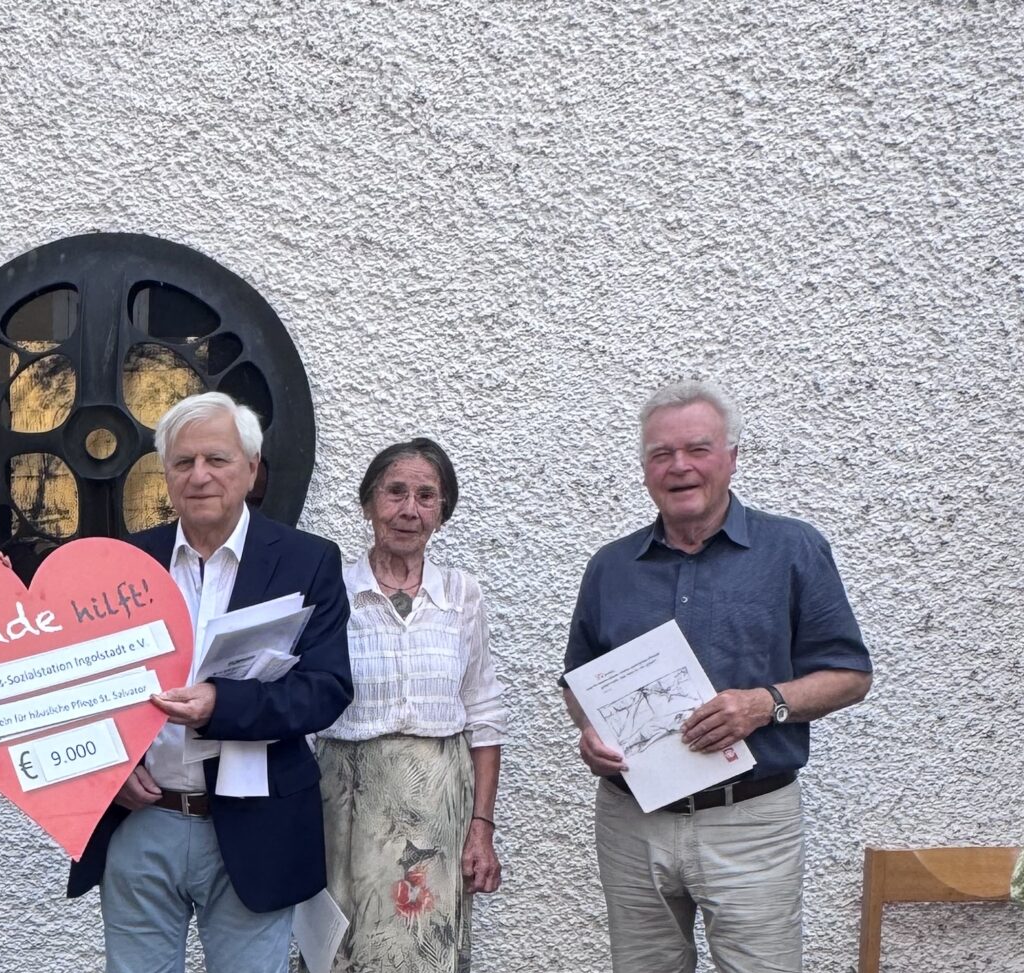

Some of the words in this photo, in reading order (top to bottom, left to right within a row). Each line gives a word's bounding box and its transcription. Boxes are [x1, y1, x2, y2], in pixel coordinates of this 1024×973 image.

[71, 579, 154, 624] hilft!
[74, 645, 127, 667] Ingolstadt
[14, 713, 27, 724] für
[112, 685, 147, 700] Salvator
[18, 750, 38, 780] €
[50, 740, 97, 767] 9.000
